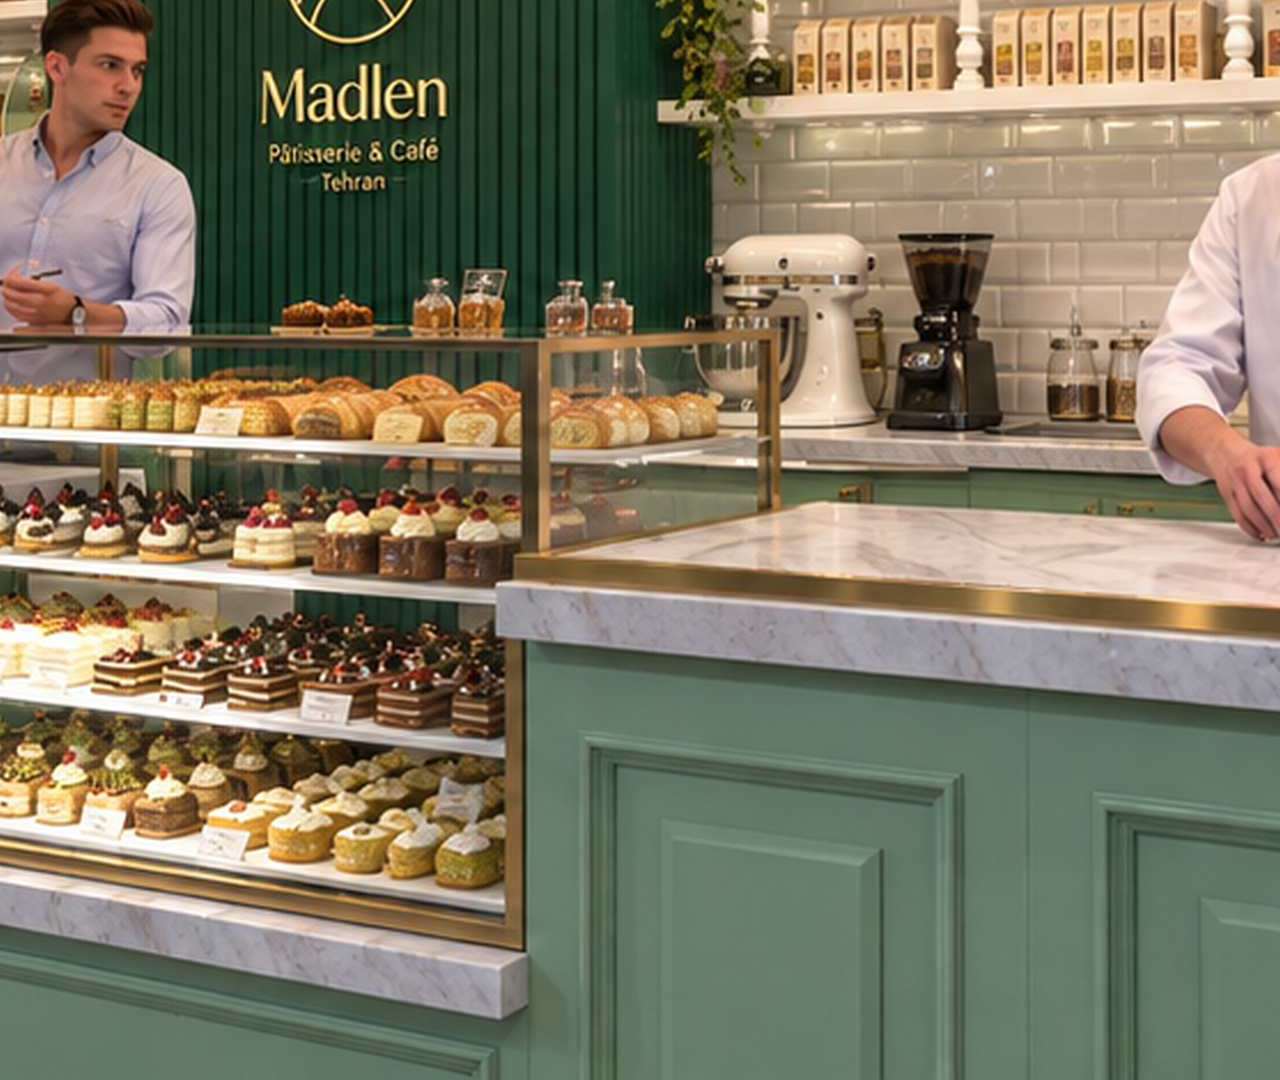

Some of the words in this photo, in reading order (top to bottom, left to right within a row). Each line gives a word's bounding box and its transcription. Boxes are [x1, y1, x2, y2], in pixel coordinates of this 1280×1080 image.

[261, 63, 447, 124] Madlen
[269, 140, 362, 164] Pâtisserie
[368, 141, 383, 163] &
[390, 137, 439, 161] Café
[322, 171, 386, 192] Tehran
